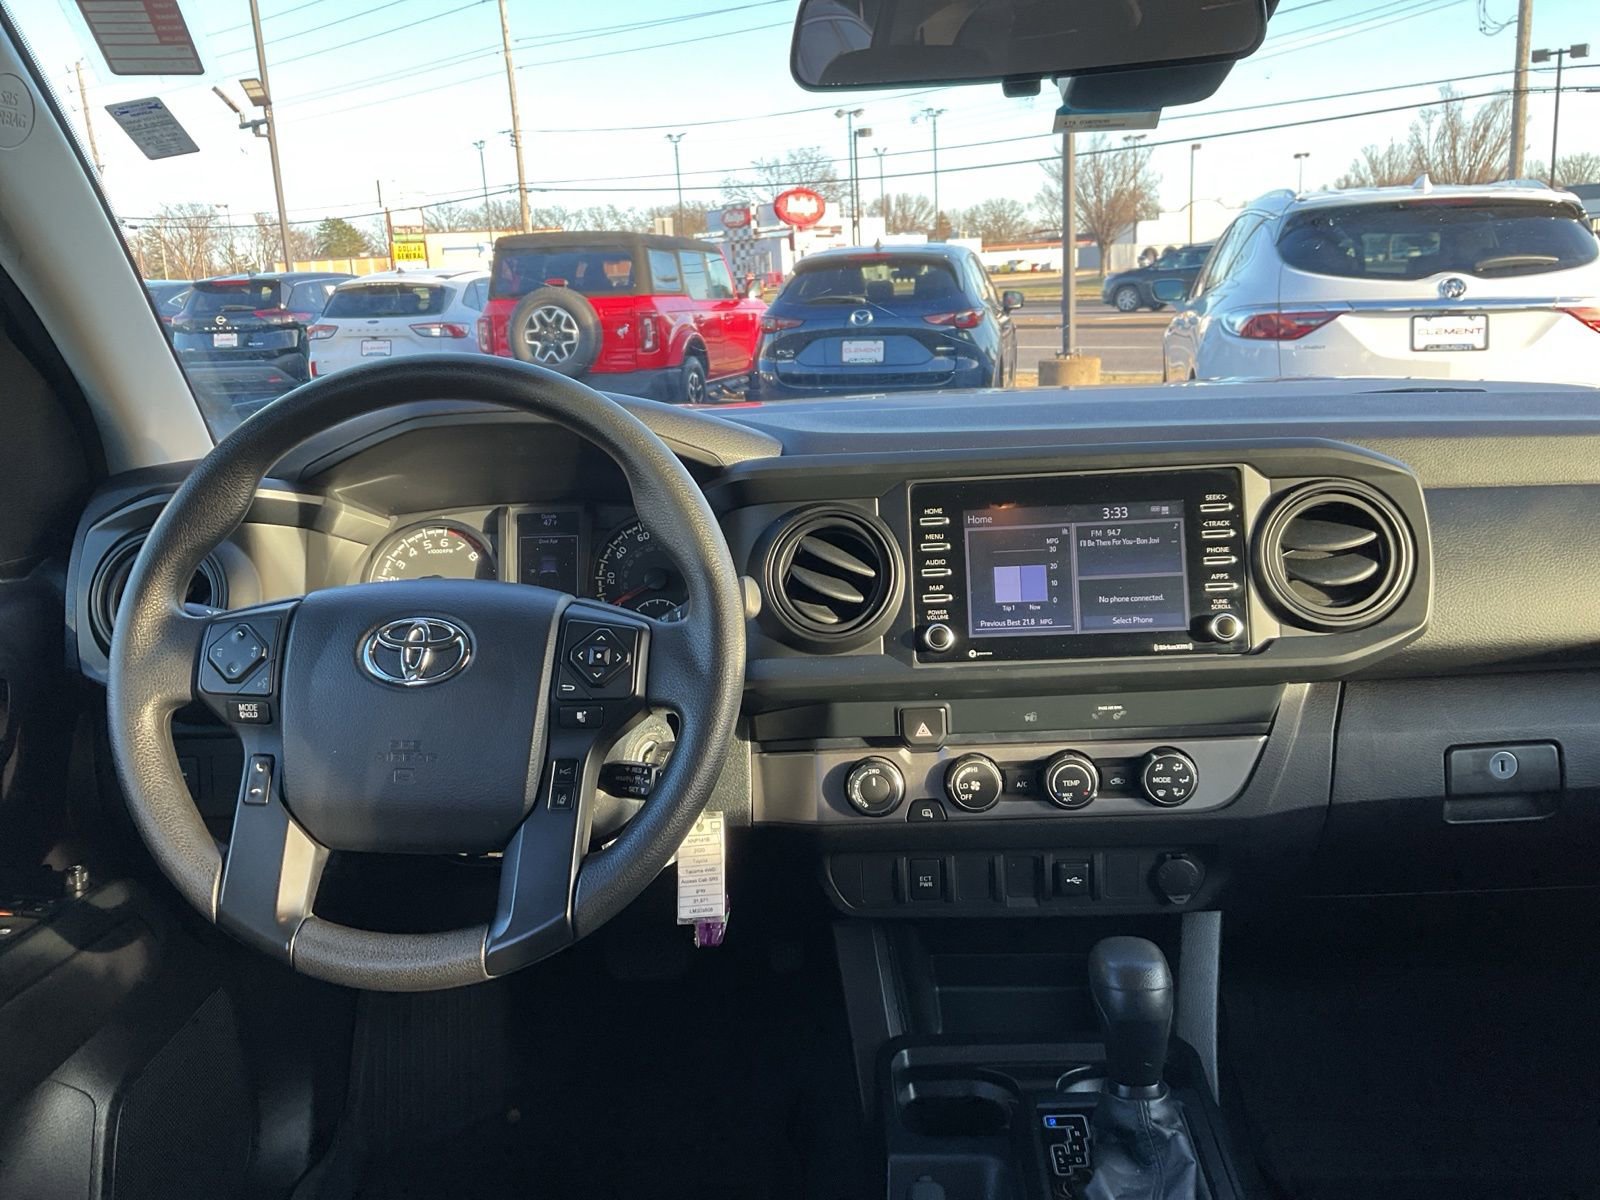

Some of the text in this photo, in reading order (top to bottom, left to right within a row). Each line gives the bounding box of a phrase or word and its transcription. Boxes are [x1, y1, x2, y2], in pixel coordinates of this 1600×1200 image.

[1418, 327, 1484, 335] CLEMENT
[1102, 506, 1128, 519] 3:33
[967, 515, 993, 524] Home
[637, 531, 650, 542] 60
[1090, 528, 1121, 537] FM 94.7
[423, 540, 432, 550] 5
[440, 538, 449, 547] 6
[1046, 537, 1059, 545] MPG
[1087, 539, 1095, 547] Be
[1096, 539, 1111, 547] There
[1112, 538, 1121, 546] For
[455, 541, 465, 551] 7
[409, 547, 418, 557] 4
[615, 546, 627, 559] 40
[468, 552, 479, 562] 8
[395, 560, 406, 570] 3
[1050, 562, 1058, 570] 20
[607, 572, 615, 585] 20
[1051, 579, 1058, 587] 10
[1098, 595, 1109, 603] No
[1110, 595, 1130, 604] phone
[1002, 604, 1012, 612] Trip
[980, 618, 1053, 628] Previous Best 21.8 MPG
[1112, 615, 1153, 624] Select Phone
[238, 703, 258, 712] MODE
[959, 782, 969, 790] LO
[1062, 779, 1081, 787] TEMP
[960, 793, 973, 801] OFF
